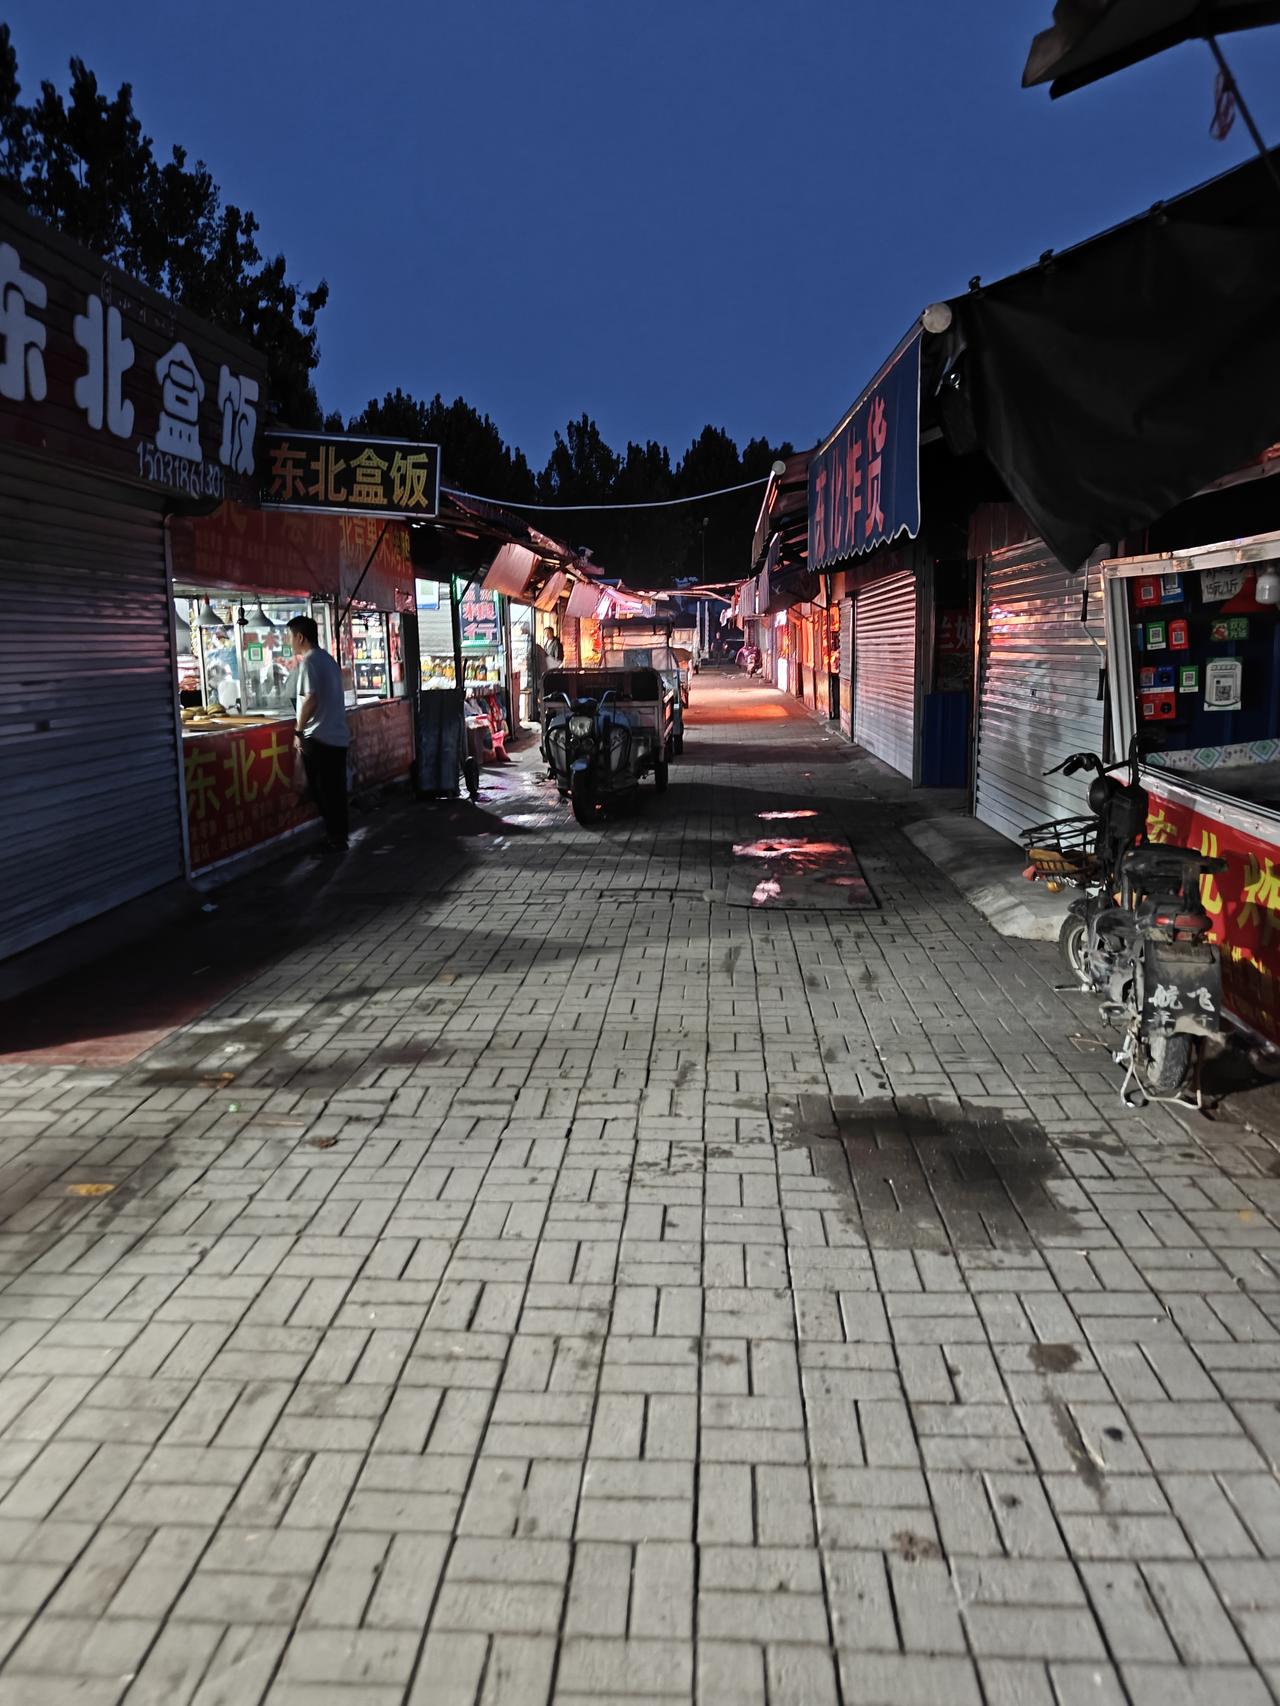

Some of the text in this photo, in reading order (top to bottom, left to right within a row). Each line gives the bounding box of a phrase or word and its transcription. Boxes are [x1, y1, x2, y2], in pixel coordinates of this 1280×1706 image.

[0, 241, 260, 477] 东北盒饭
[269, 441, 429, 509] 东北盒饭
